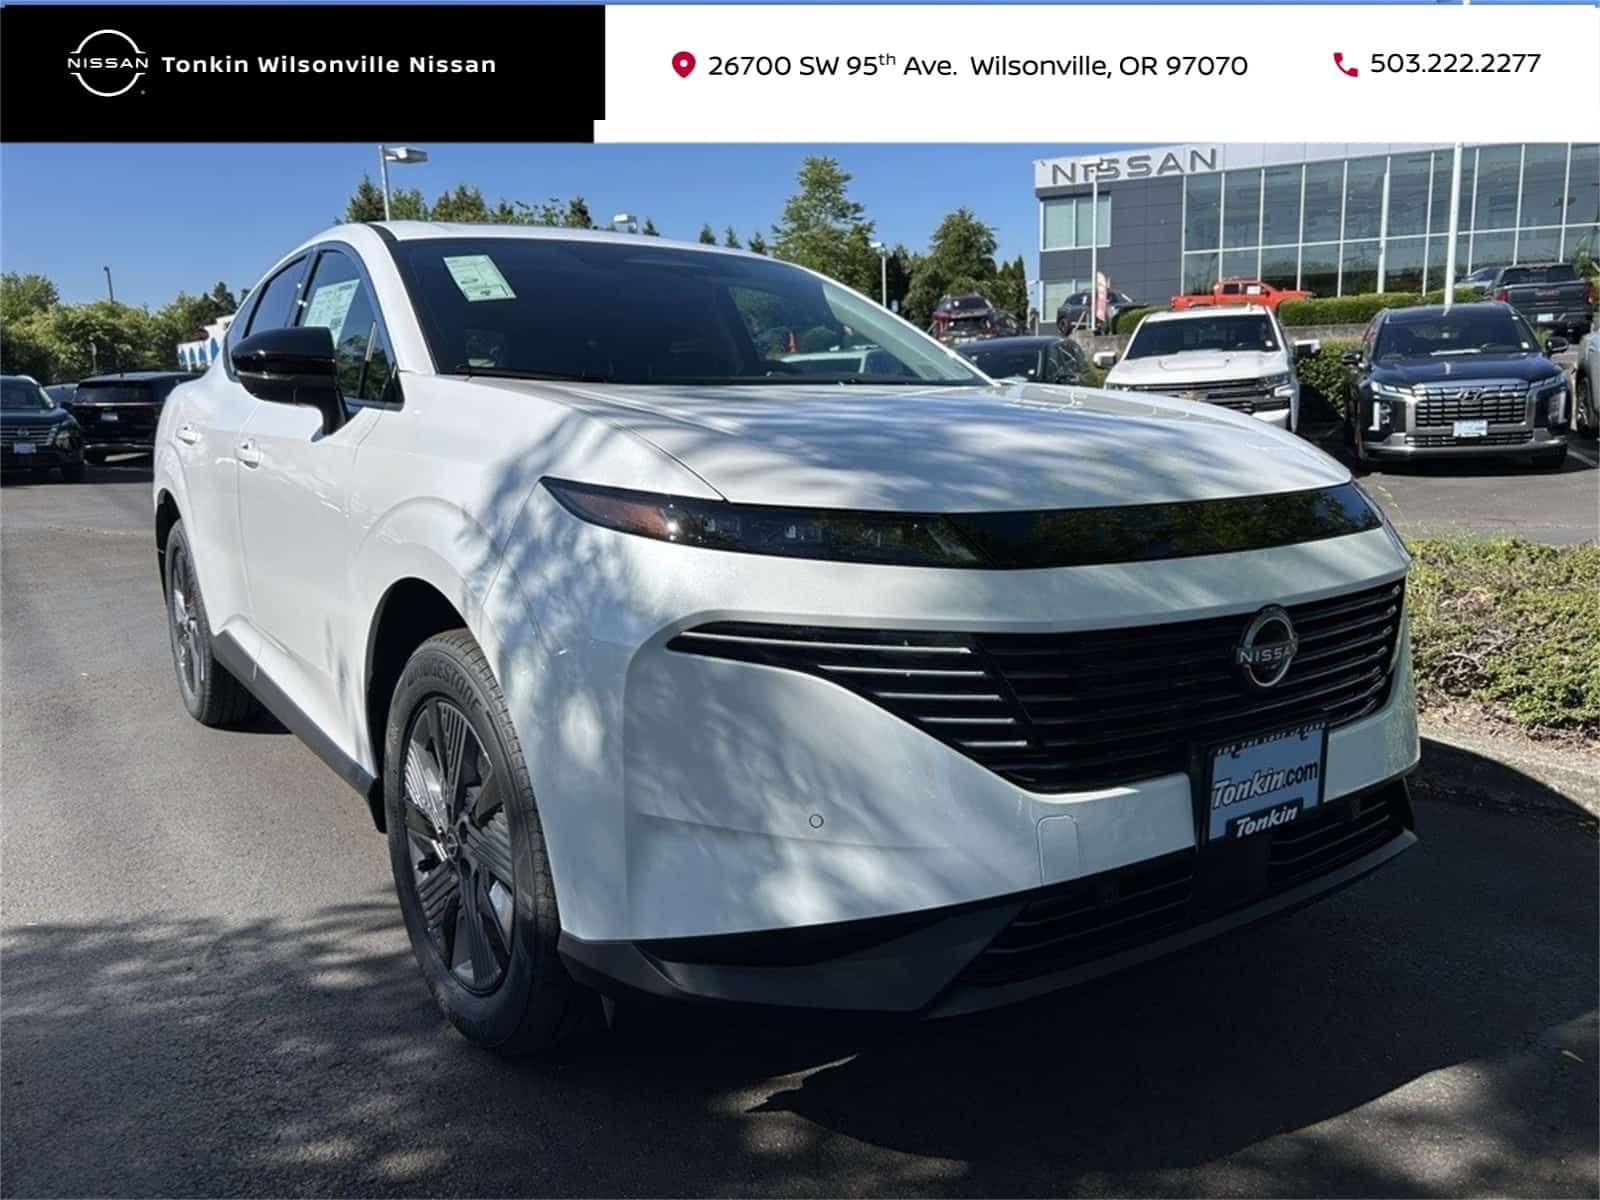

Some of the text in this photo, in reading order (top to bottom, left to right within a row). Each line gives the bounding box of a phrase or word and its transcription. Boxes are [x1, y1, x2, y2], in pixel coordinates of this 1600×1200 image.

[1052, 148, 1217, 185] NISSAN
[1239, 641, 1297, 663] NISSAN
[1212, 762, 1318, 809] Tonkin.com
[1236, 805, 1298, 838] Tonkin
